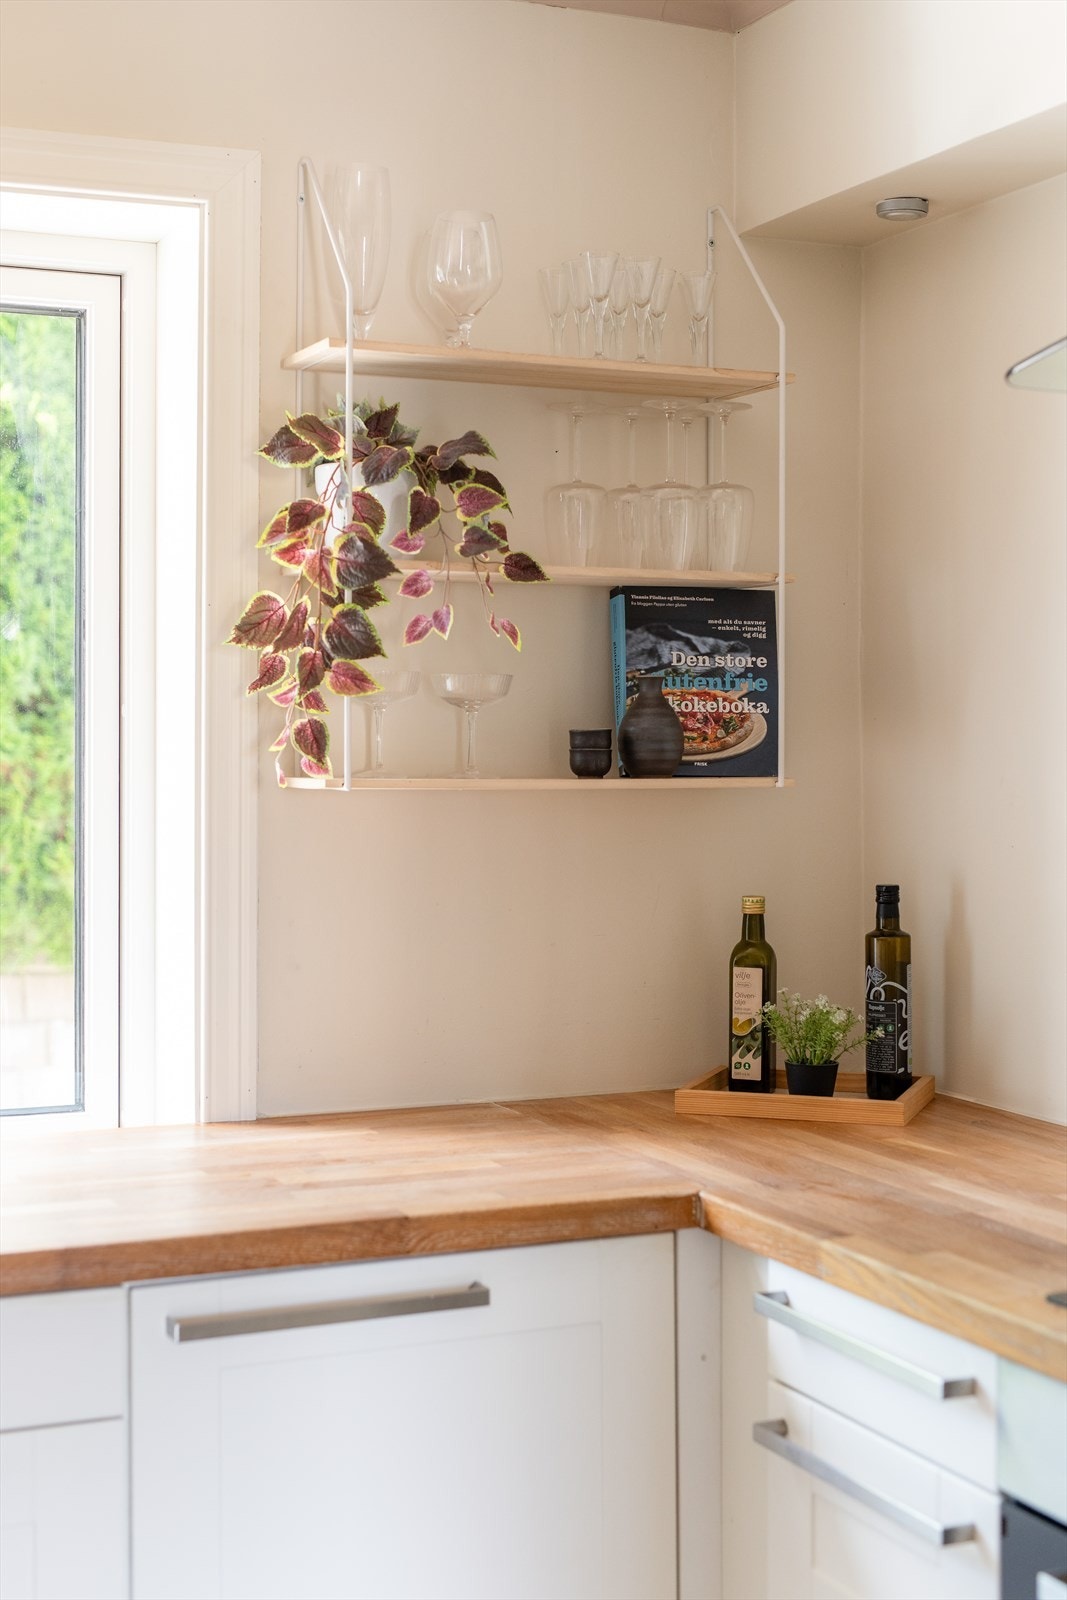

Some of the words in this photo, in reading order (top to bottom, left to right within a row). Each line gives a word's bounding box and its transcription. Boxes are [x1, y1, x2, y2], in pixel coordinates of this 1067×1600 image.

[671, 651, 711, 667] Den
[714, 653, 768, 668] store
[651, 671, 768, 691] utenfrie
[665, 696, 770, 714] kokeboka
[735, 971, 751, 980] vilje
[734, 991, 757, 999] Oliven-
